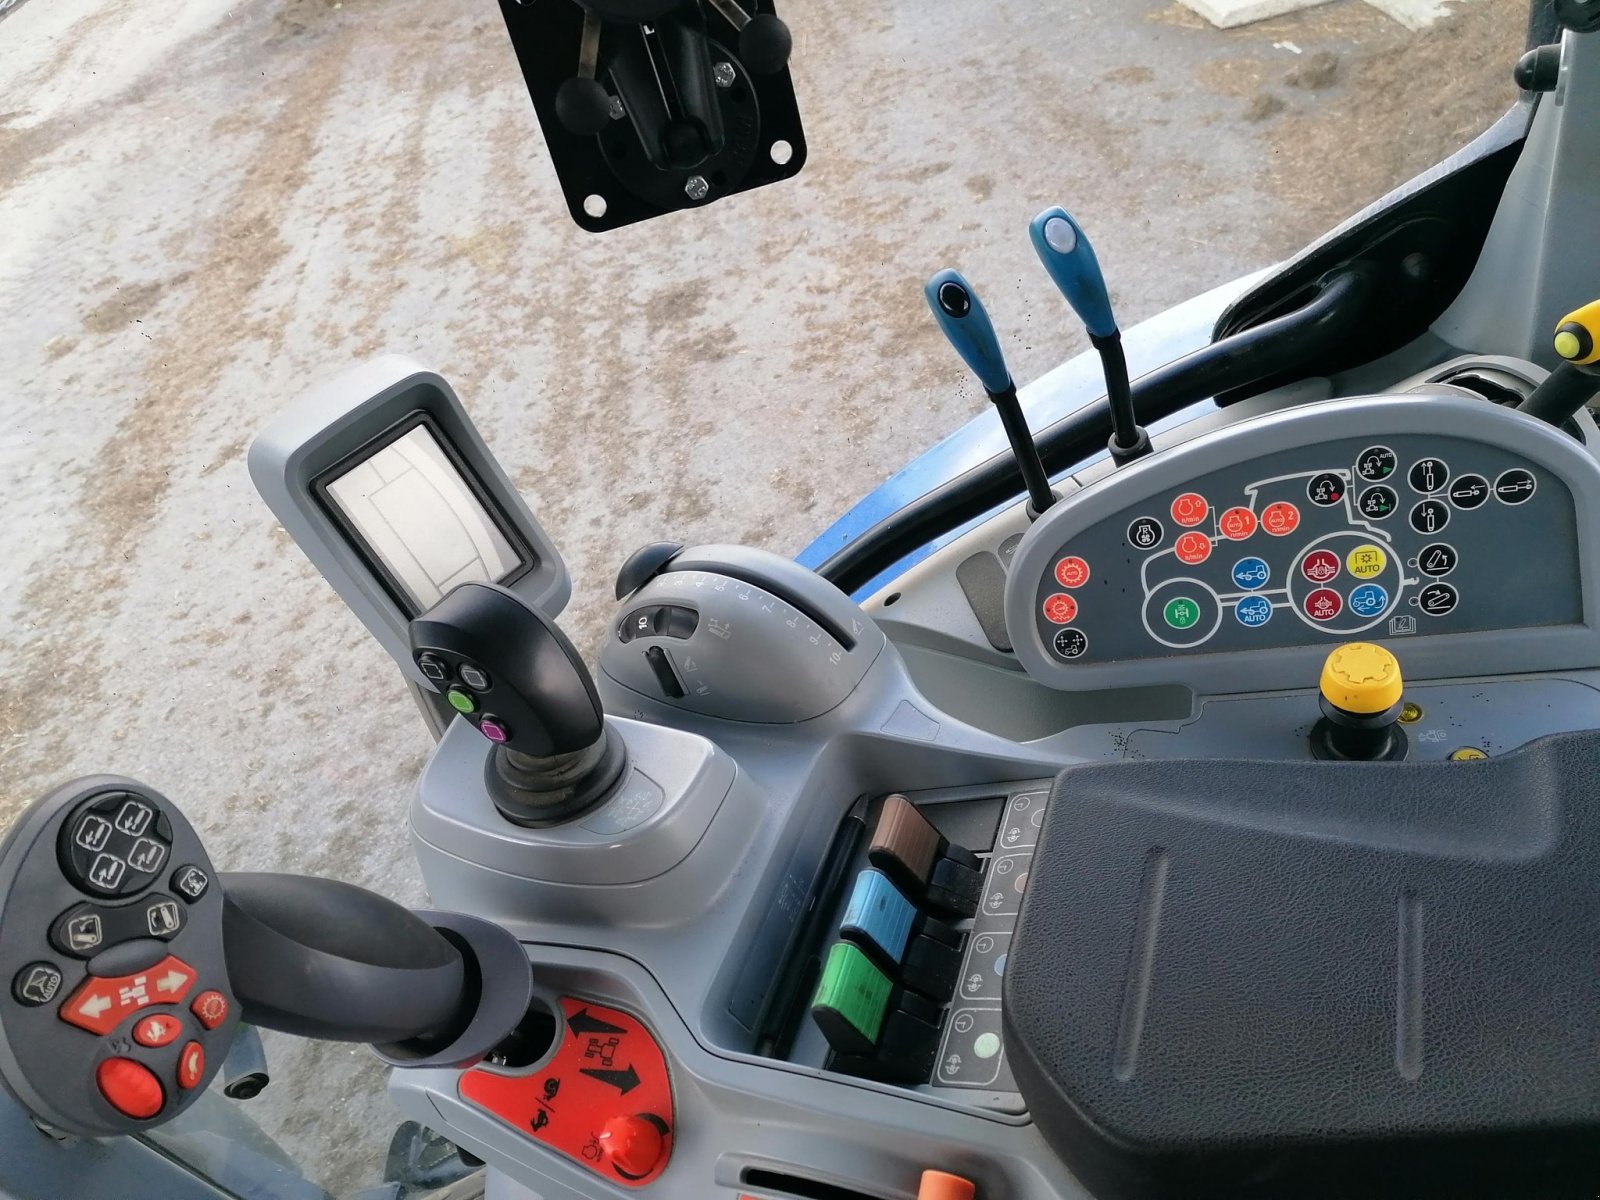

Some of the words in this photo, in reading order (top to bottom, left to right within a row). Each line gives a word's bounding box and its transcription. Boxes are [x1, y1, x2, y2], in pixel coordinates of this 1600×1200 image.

[1288, 511, 1294, 520] 2
[1354, 564, 1380, 574] AUTO
[738, 593, 749, 601] 6
[762, 605, 772, 613] 7
[1314, 609, 1335, 617] AUTO
[638, 617, 648, 630] 10
[786, 619, 796, 628] 8
[1244, 615, 1266, 623] AUTO
[809, 636, 818, 645] 9
[829, 652, 841, 665] 10
[42, 976, 58, 999] AUTO
